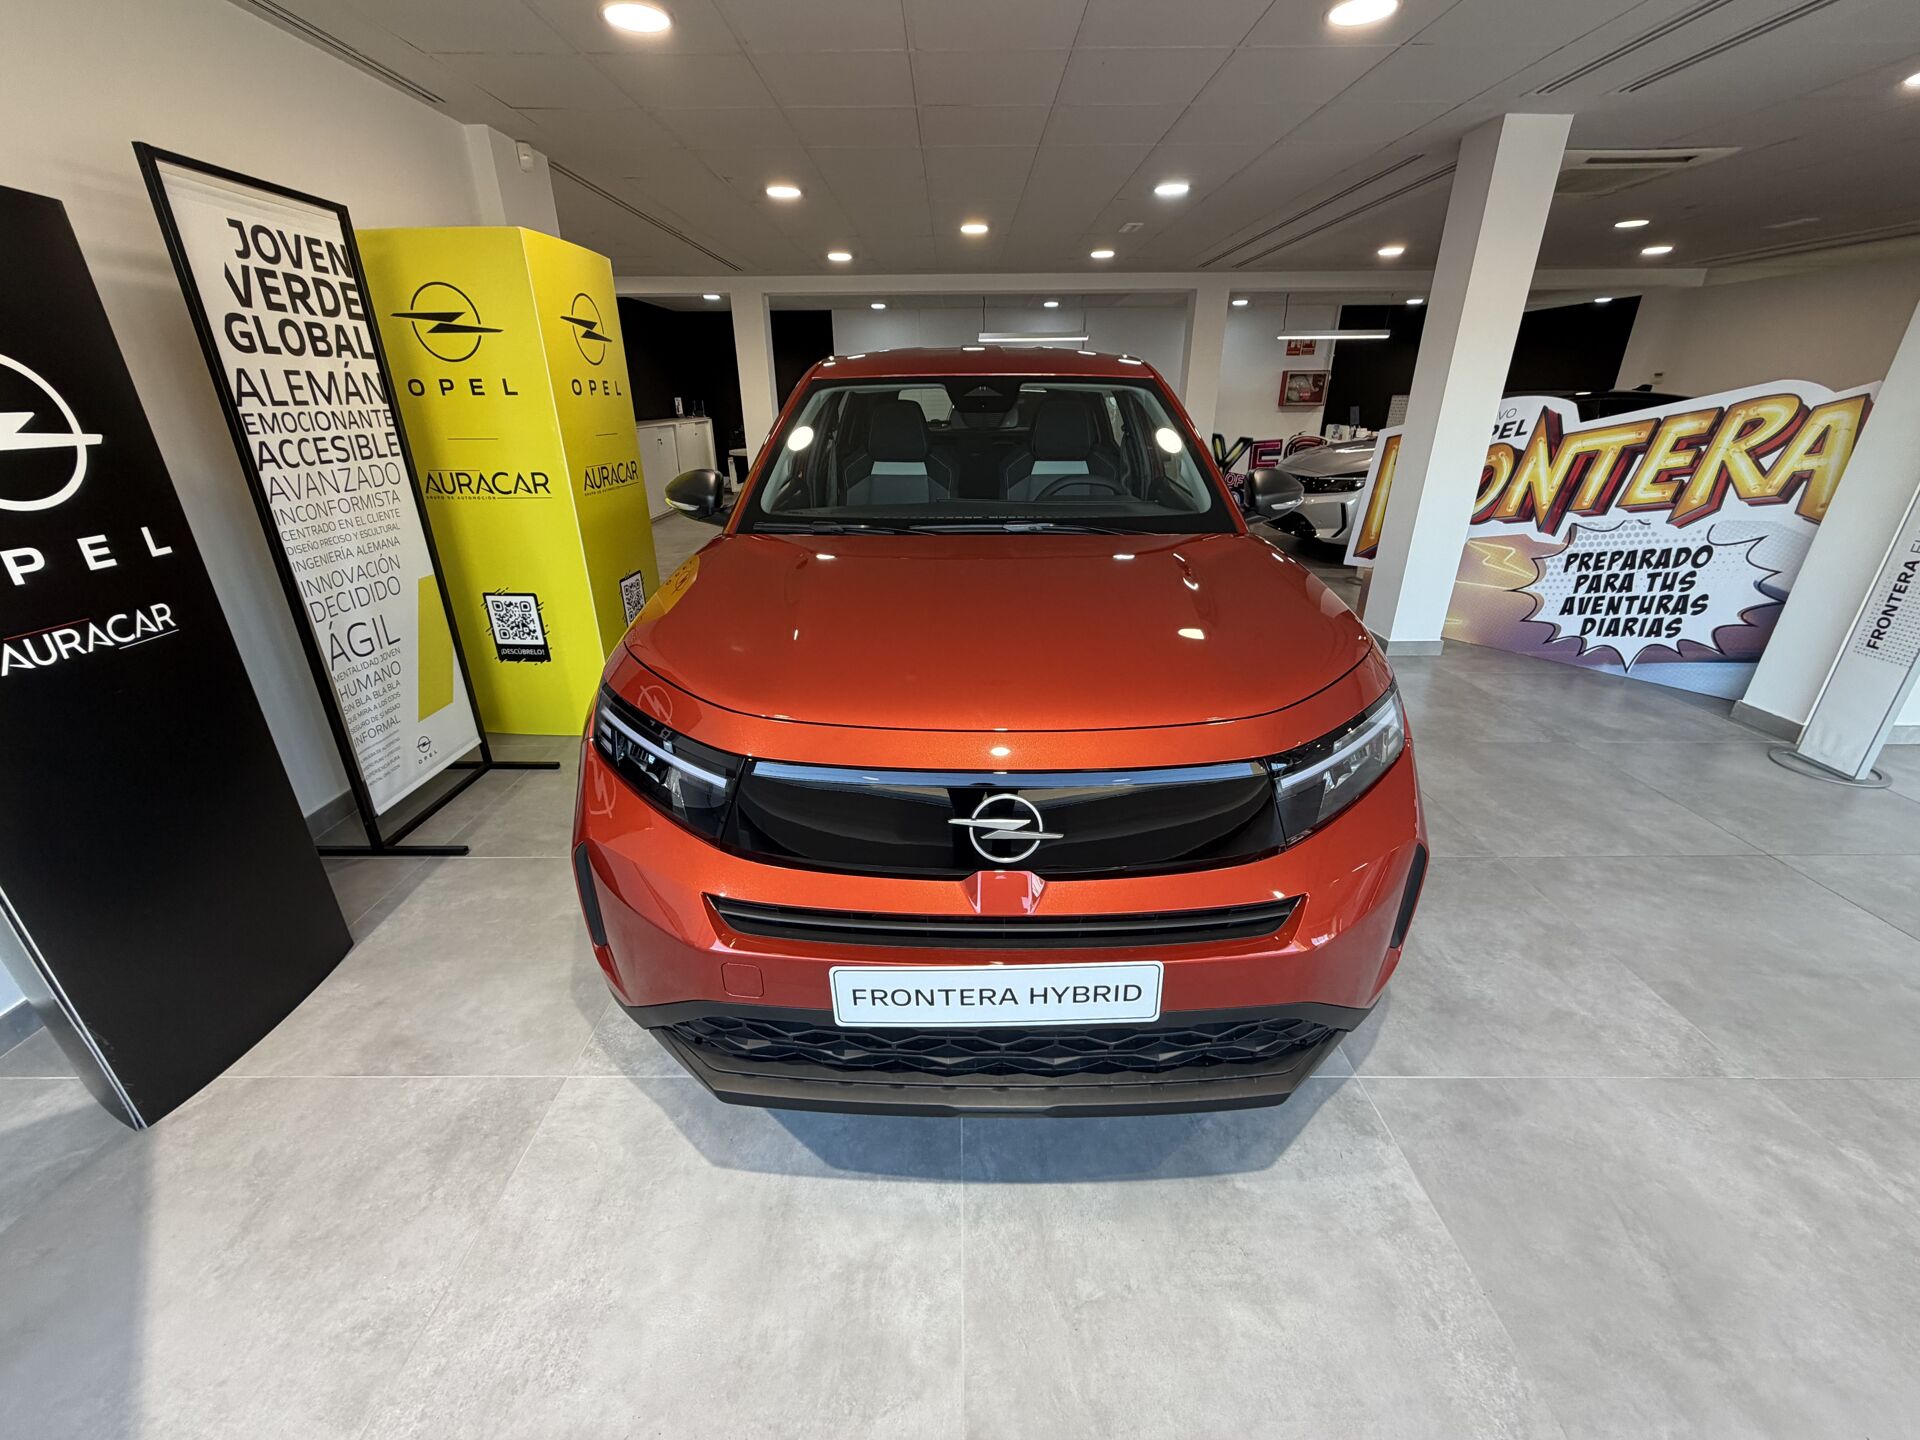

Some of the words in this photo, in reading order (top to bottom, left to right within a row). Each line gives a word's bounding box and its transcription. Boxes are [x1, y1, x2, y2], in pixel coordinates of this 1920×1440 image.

[226, 217, 354, 279] JOVEN
[224, 262, 367, 322] VERDE
[224, 312, 377, 360] GLOBAL
[236, 361, 389, 408] ALEMÁN
[407, 377, 519, 397] OPEL
[571, 377, 622, 396] OPEL
[240, 408, 396, 436] EMOCIONANTE
[258, 431, 401, 472] ACCESIBLE
[269, 461, 401, 504] AVANZADO
[425, 471, 551, 495] AURACAR
[584, 460, 639, 492] AURACAR
[273, 489, 401, 527] INCONFORMISTA
[281, 521, 337, 542] CENTRADO
[338, 517, 354, 530] EN
[354, 515, 366, 527] EL
[366, 508, 401, 524] CLIENTE
[0, 526, 173, 586] PEL
[286, 540, 320, 556] DISEÑO
[320, 533, 352, 548] PRECISO
[353, 532, 358, 541] Y
[360, 523, 401, 538] ESCULTURAL
[291, 546, 355, 573] INGENIERÍA
[356, 536, 401, 557] ALEMANA
[300, 553, 401, 598] INNOVACIÓN
[1563, 544, 1714, 573] PREPARADO
[309, 575, 401, 623] DECIDIDO
[1573, 572, 1635, 594] PARA
[1646, 570, 1698, 593] TUS
[1558, 593, 1710, 616] AVENTURAS
[1865, 559, 1920, 650] FRONTERA
[0, 602, 177, 677] AURACAR
[328, 614, 401, 671] ÁGIL
[1579, 617, 1683, 638] DIARIAS
[334, 657, 380, 682] MENTALIDAD
[380, 647, 401, 662] JOVEN
[338, 660, 402, 703] HUMANO
[343, 702, 356, 715] SIN
[355, 694, 373, 708] BLA
[372, 687, 388, 700] BLA
[387, 680, 401, 692] BLA
[354, 715, 401, 748] INFORMAL
[851, 986, 1019, 1007] FRONTERA
[1029, 984, 1143, 1005] HYBRID
